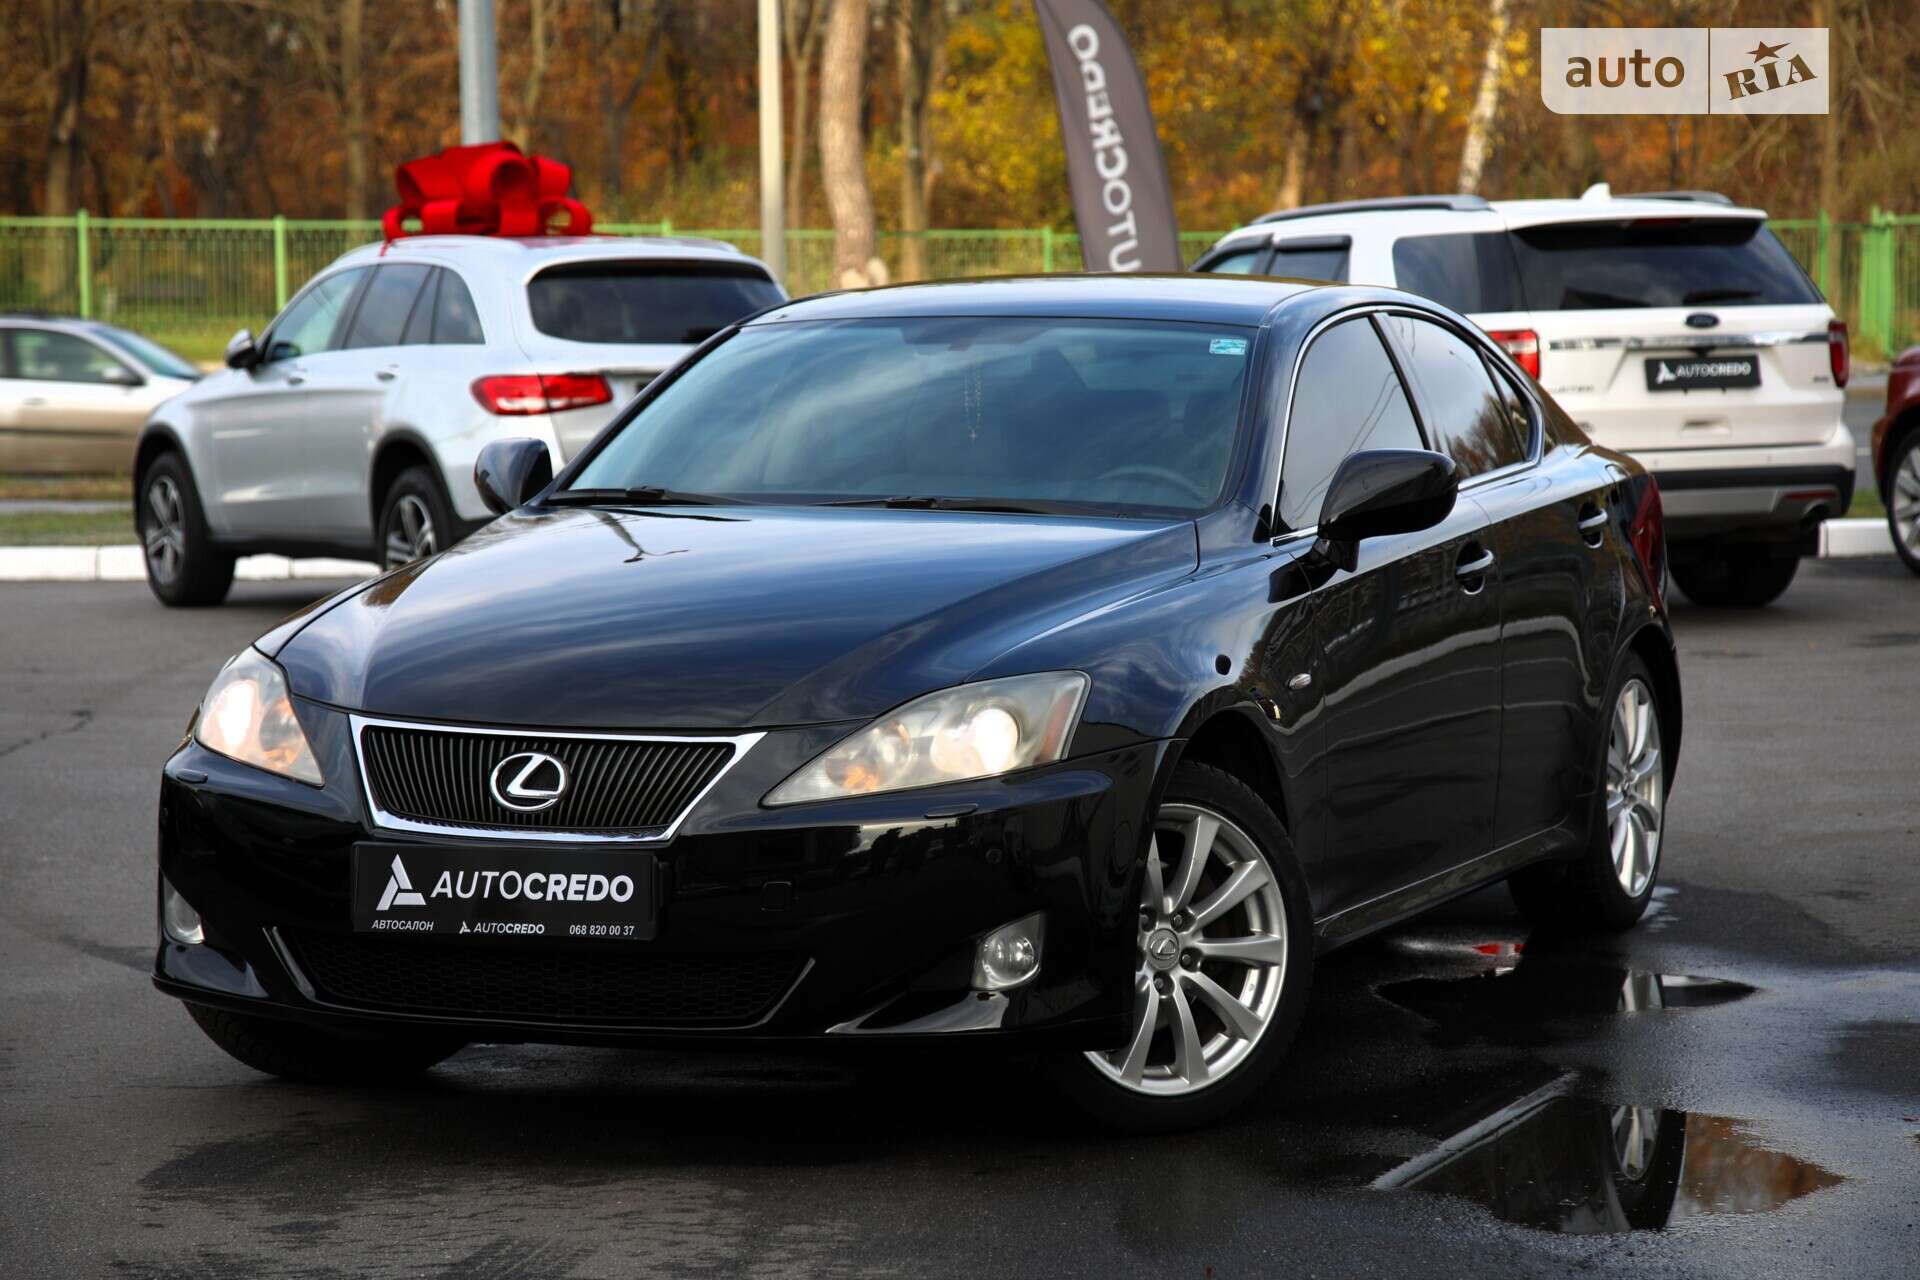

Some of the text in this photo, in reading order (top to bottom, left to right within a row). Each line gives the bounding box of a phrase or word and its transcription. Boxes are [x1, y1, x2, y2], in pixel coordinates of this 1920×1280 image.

[1676, 362, 1752, 378] AUTOCREDO
[430, 870, 635, 903] AUTOCREDO
[371, 919, 434, 931] АВТОСАЛОН
[473, 922, 545, 935] AUTOCREDO
[569, 924, 635, 936] 068 820 00 37
